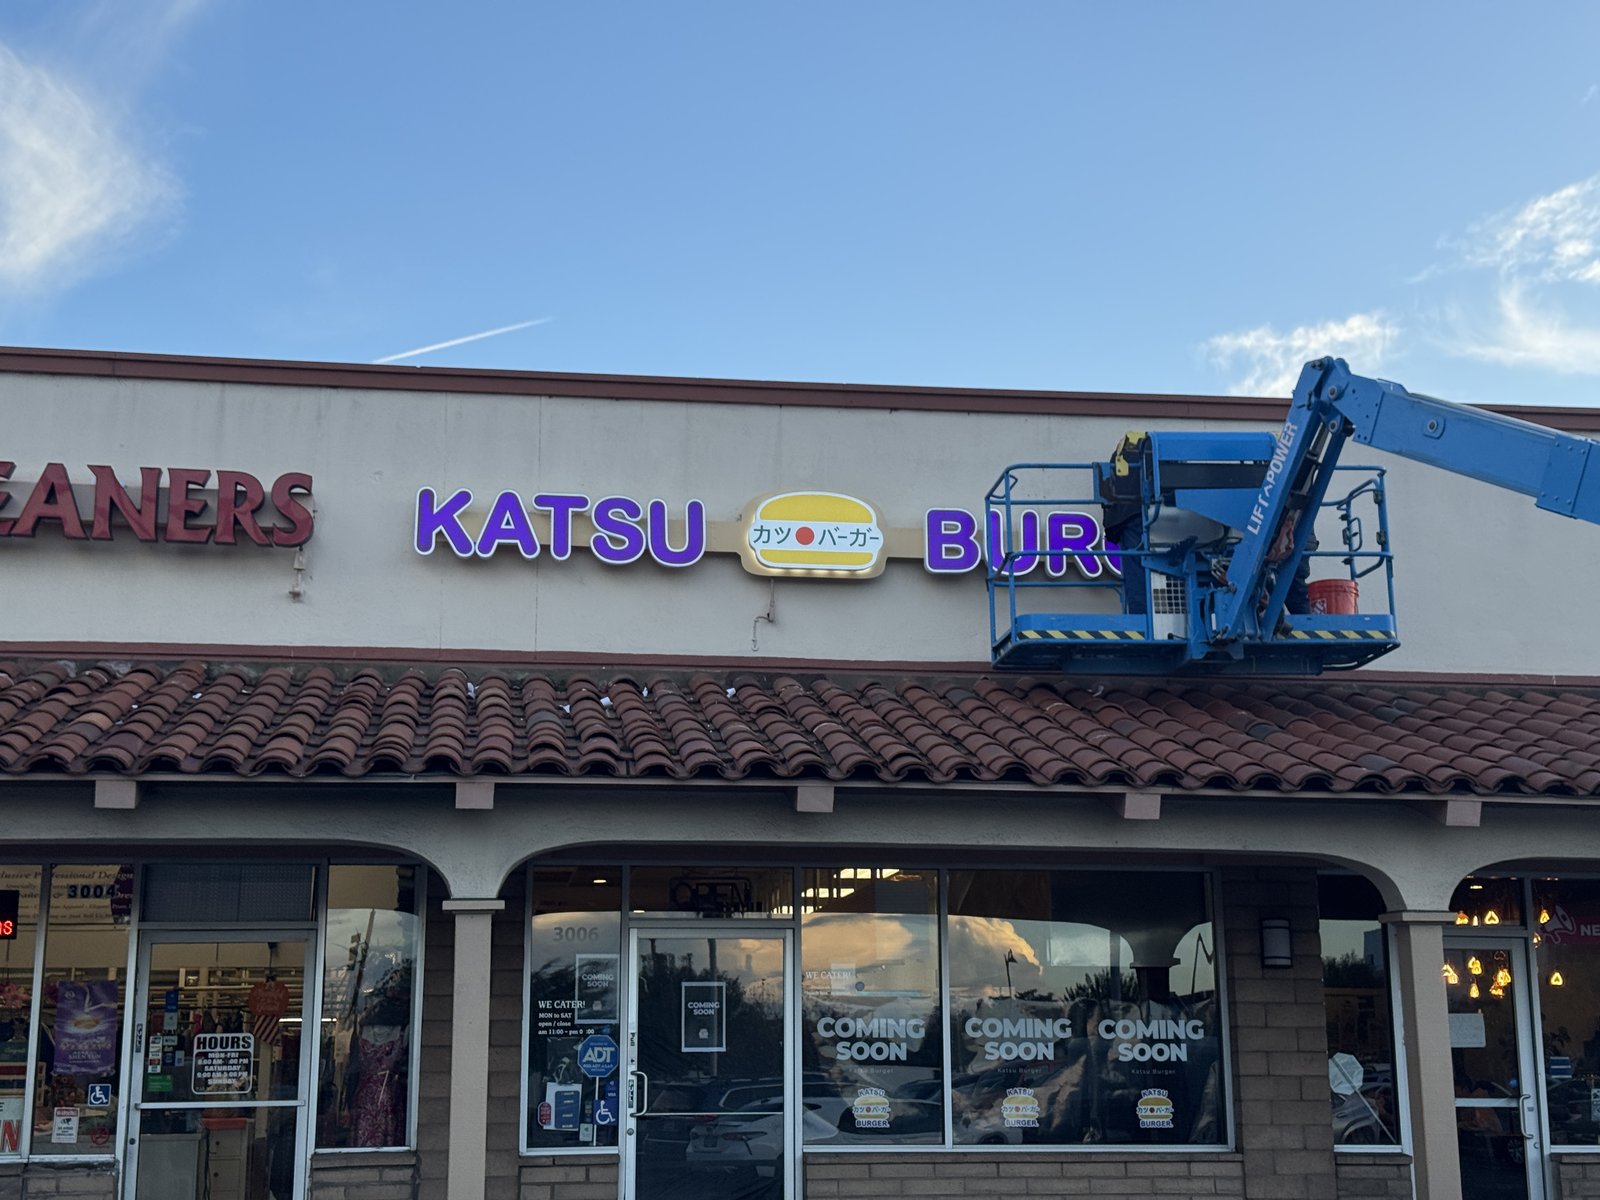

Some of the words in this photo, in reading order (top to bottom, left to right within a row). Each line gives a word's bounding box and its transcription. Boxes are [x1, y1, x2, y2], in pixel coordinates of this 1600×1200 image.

[1247, 497, 1270, 535] LIFT
[1267, 422, 1298, 485] POWER
[414, 486, 706, 567] KATSU
[753, 525, 792, 545] カツ
[818, 526, 880, 548] バーガー
[68, 884, 116, 899] 3004
[552, 926, 600, 942] 3006
[581, 973, 614, 981] COMING
[538, 1000, 552, 1009] WE
[554, 1000, 586, 1009] CATER!
[687, 1001, 720, 1009] COMING
[692, 1008, 715, 1016] SOON
[816, 1017, 925, 1039] COMING
[965, 1017, 1072, 1039] COMING
[1098, 1019, 1204, 1040] COMING
[196, 1036, 251, 1050] HOURS
[836, 1041, 907, 1061] SOON
[984, 1041, 1055, 1061] SOON
[582, 1046, 615, 1063] ADT
[1118, 1043, 1188, 1062] SOON
[1152, 1068, 1176, 1076] Burger
[858, 1088, 885, 1097] KATSU
[1007, 1088, 1034, 1097] KATSU
[1141, 1088, 1168, 1098] KATSU
